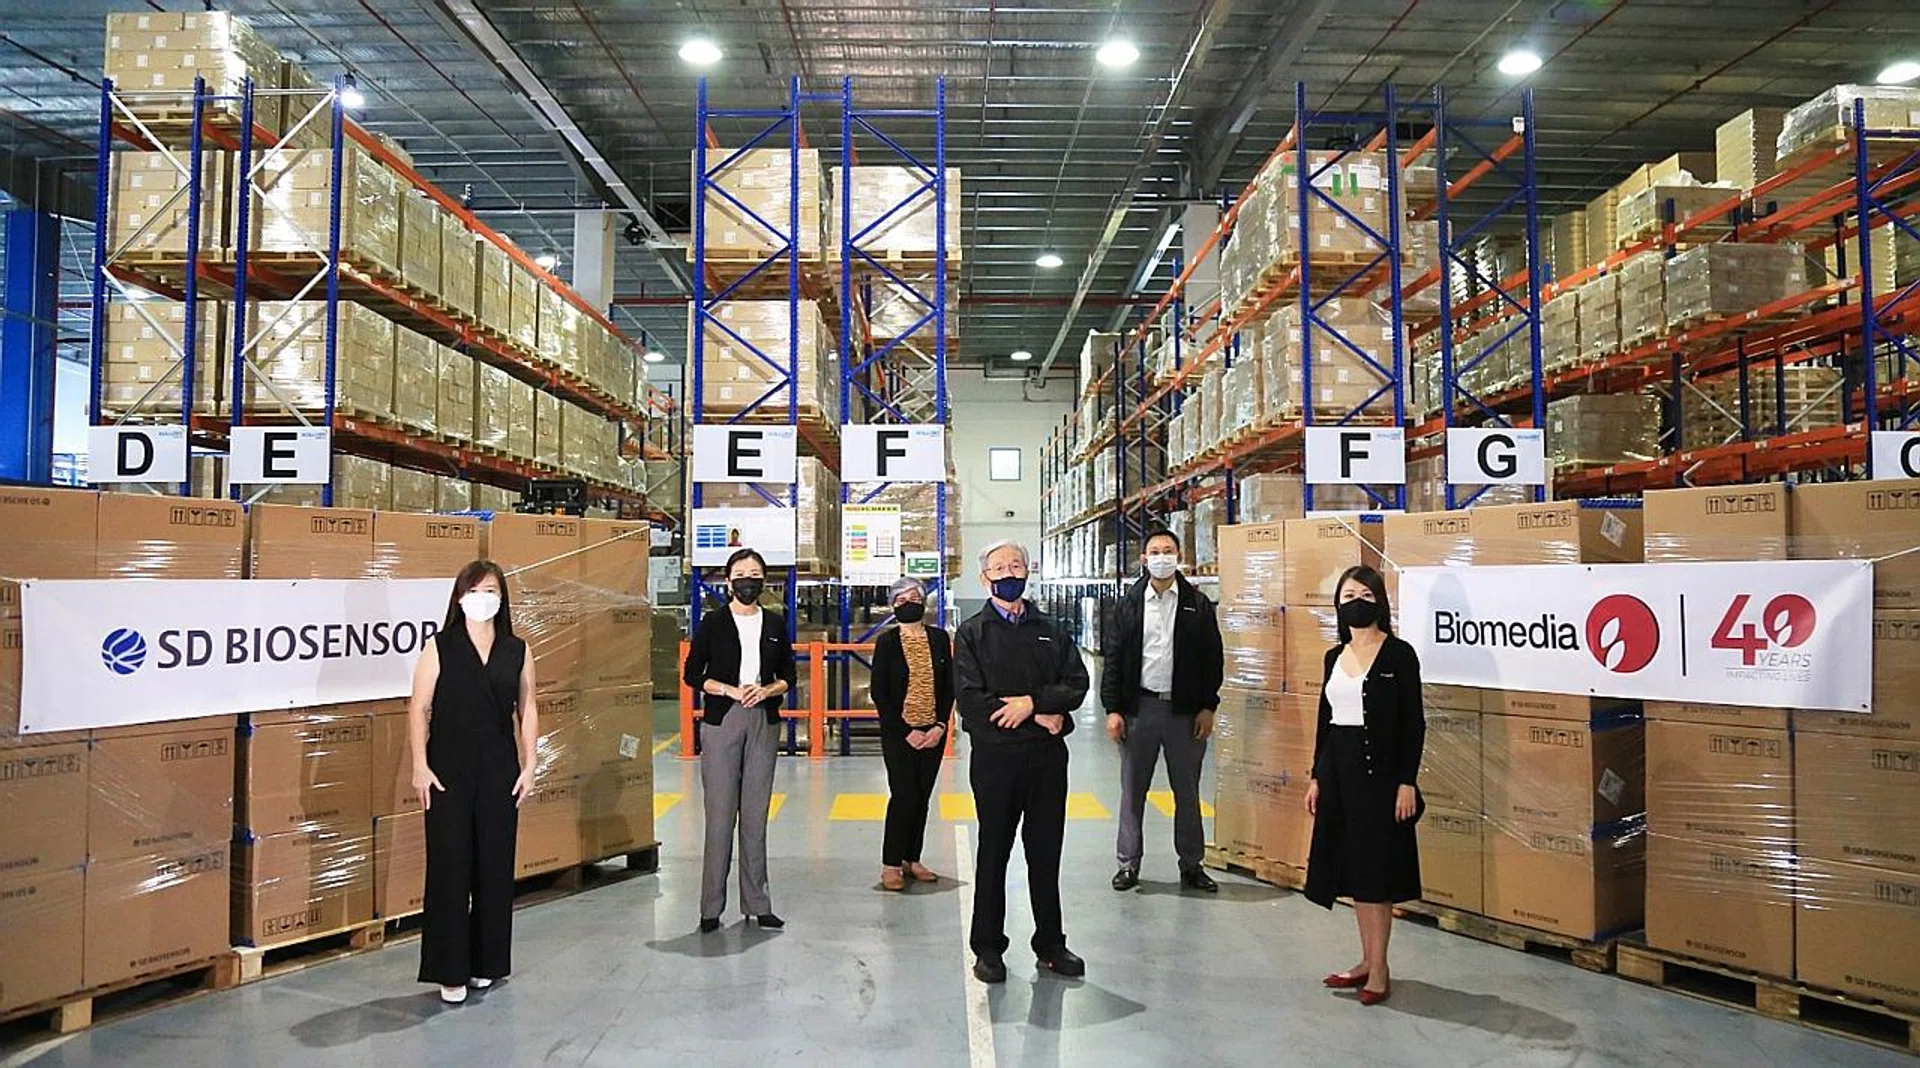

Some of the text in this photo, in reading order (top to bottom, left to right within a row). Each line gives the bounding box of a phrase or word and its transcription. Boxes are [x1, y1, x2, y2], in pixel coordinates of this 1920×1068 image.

[117, 431, 154, 476] D
[263, 432, 297, 478] E
[727, 431, 763, 477] E
[876, 430, 909, 476] F
[1340, 432, 1371, 478] F
[1477, 433, 1517, 478] G
[157, 629, 213, 669] SD
[1435, 611, 1580, 650] Biomedia
[1759, 653, 1812, 667] YEARS
